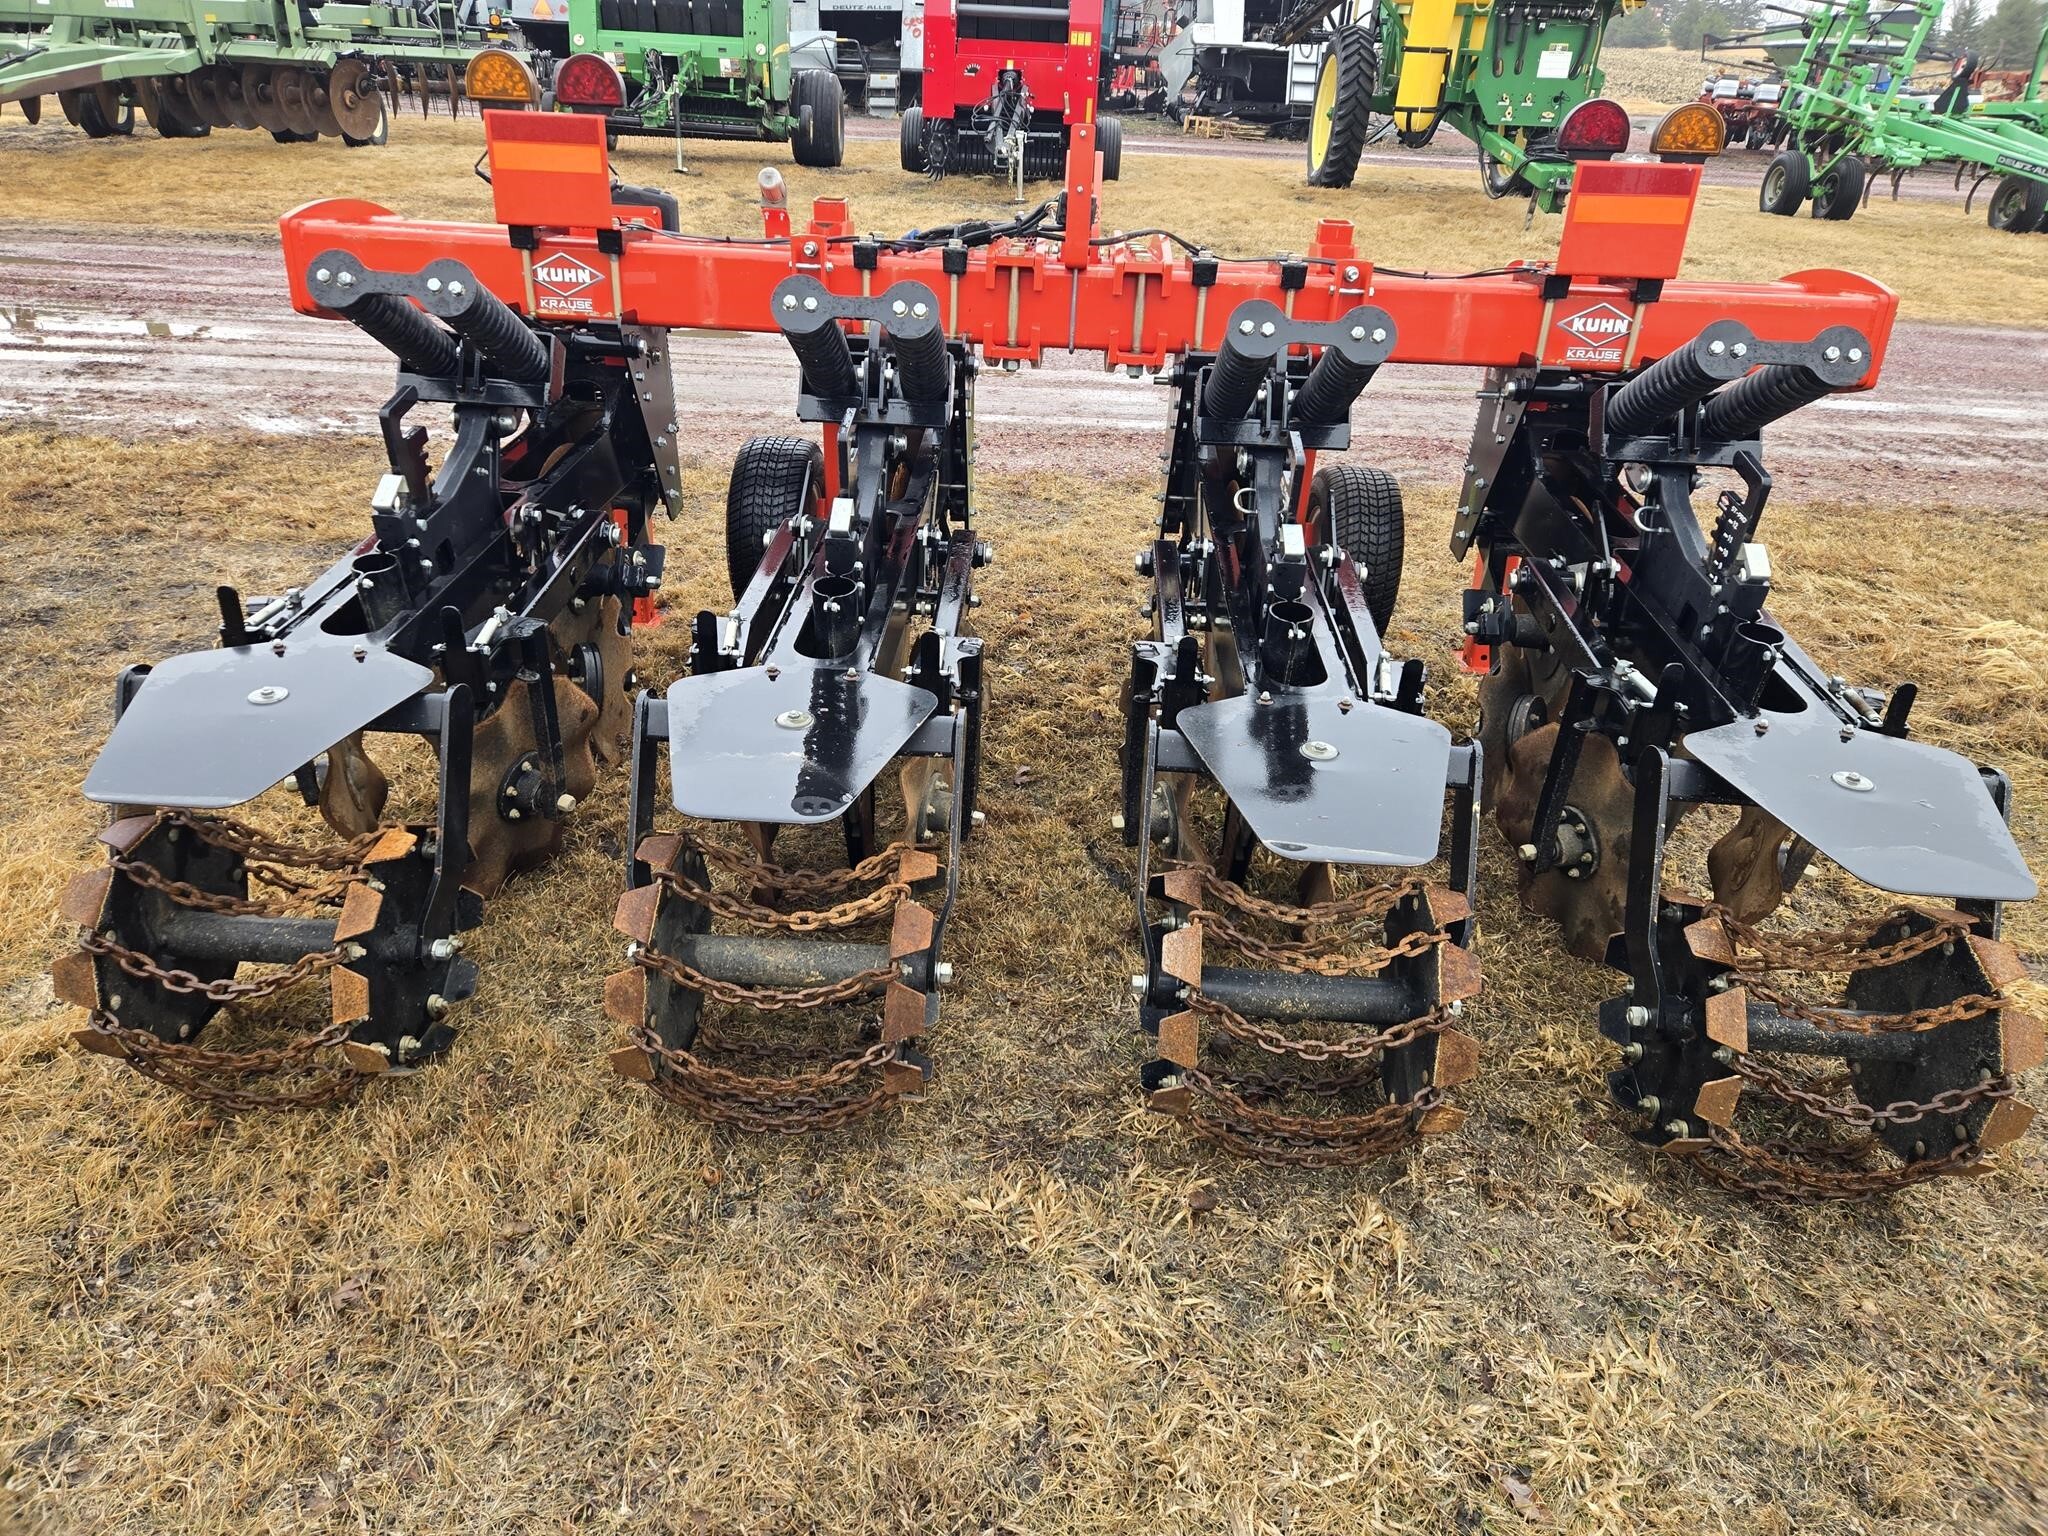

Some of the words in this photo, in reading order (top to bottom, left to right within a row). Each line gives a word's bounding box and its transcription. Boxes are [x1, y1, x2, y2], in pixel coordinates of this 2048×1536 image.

[536, 267, 591, 283] KUHN
[540, 299, 592, 310] KRAUSE
[1572, 317, 1629, 333] KUHN
[1566, 349, 1622, 360] KRAUSE
